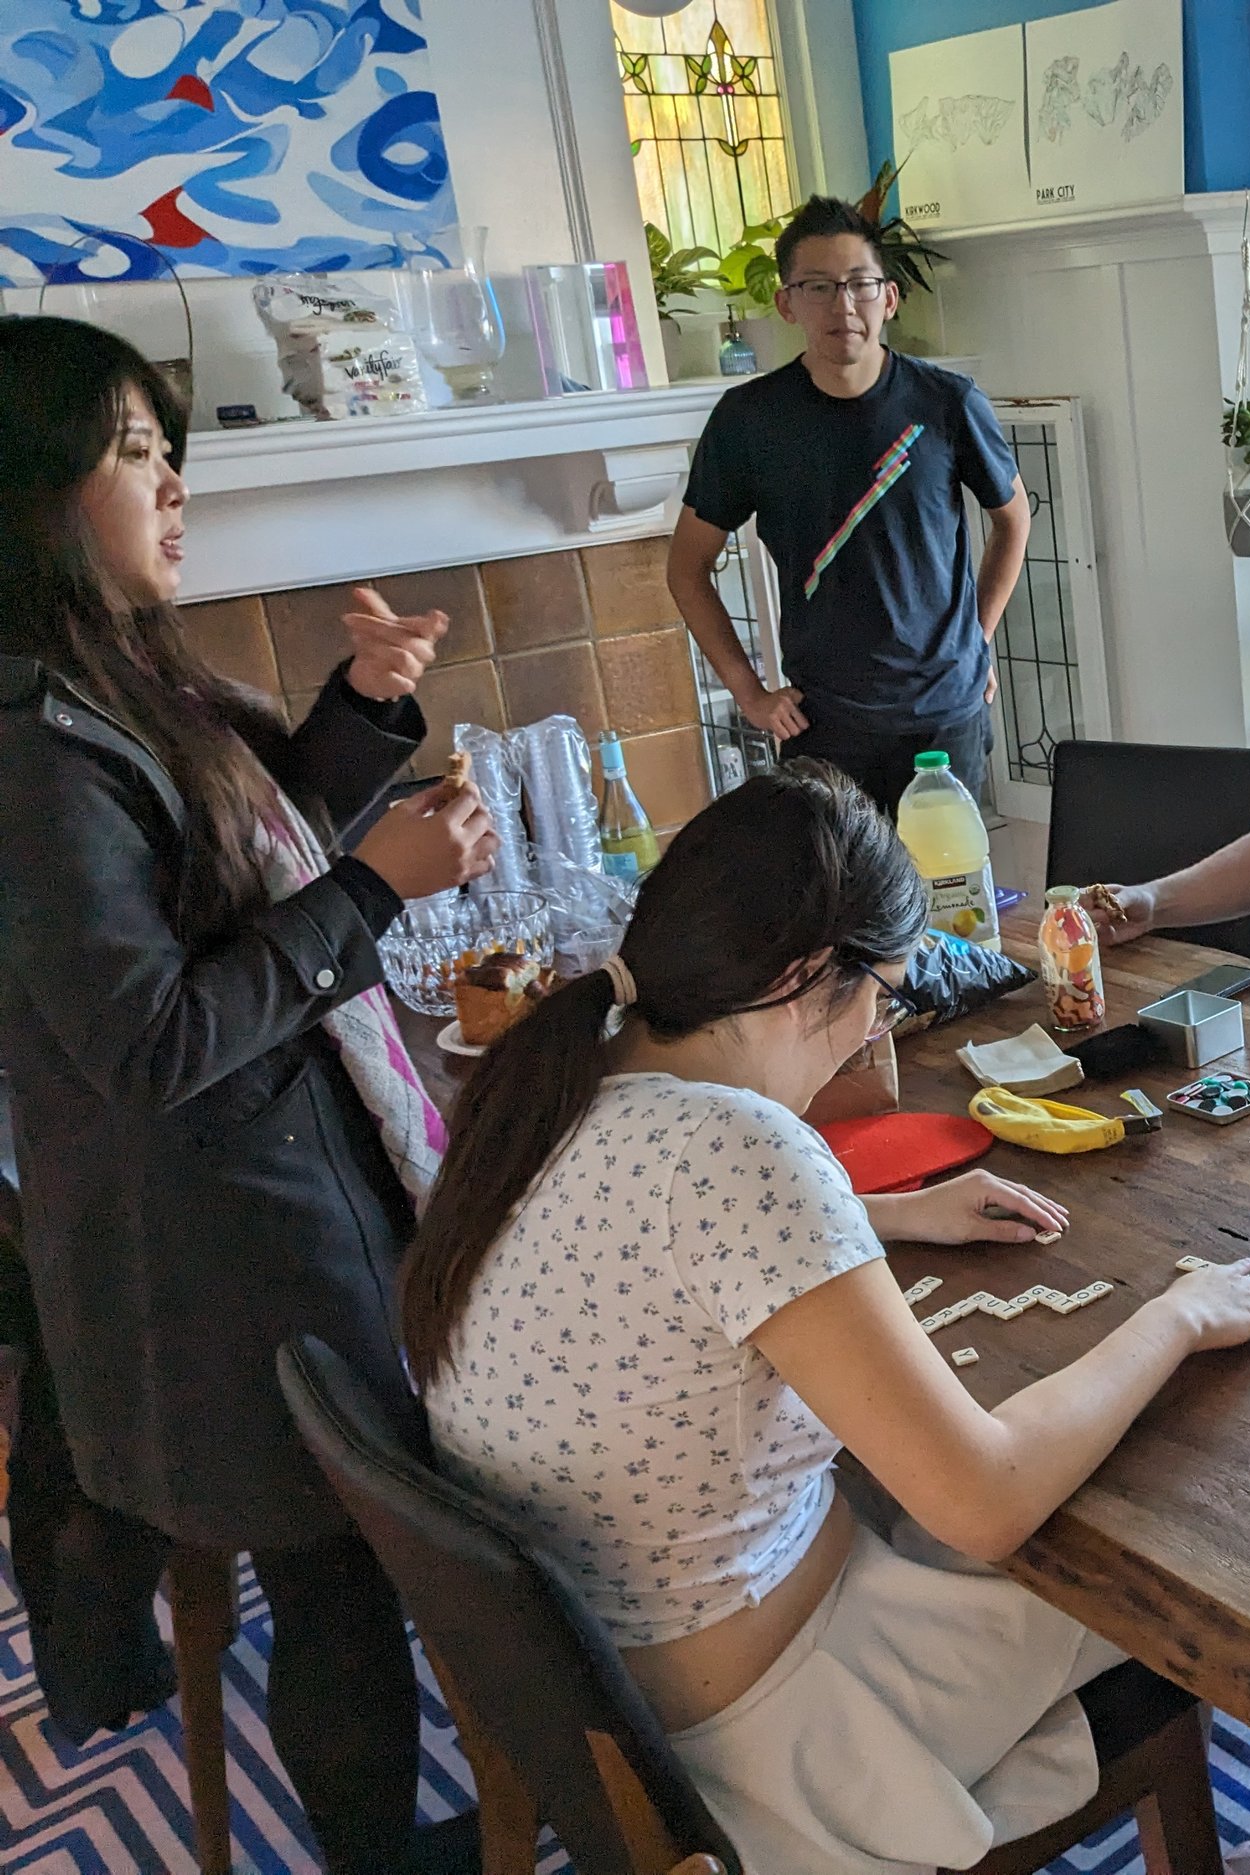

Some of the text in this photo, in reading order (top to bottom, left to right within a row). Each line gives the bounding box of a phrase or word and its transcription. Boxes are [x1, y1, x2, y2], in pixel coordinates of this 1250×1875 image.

[1036, 184, 1075, 200] PARK CITY
[905, 202, 941, 215] KIRKWOOD
[934, 877, 966, 887] KIRKLAND
[930, 895, 976, 911] Lemonade
